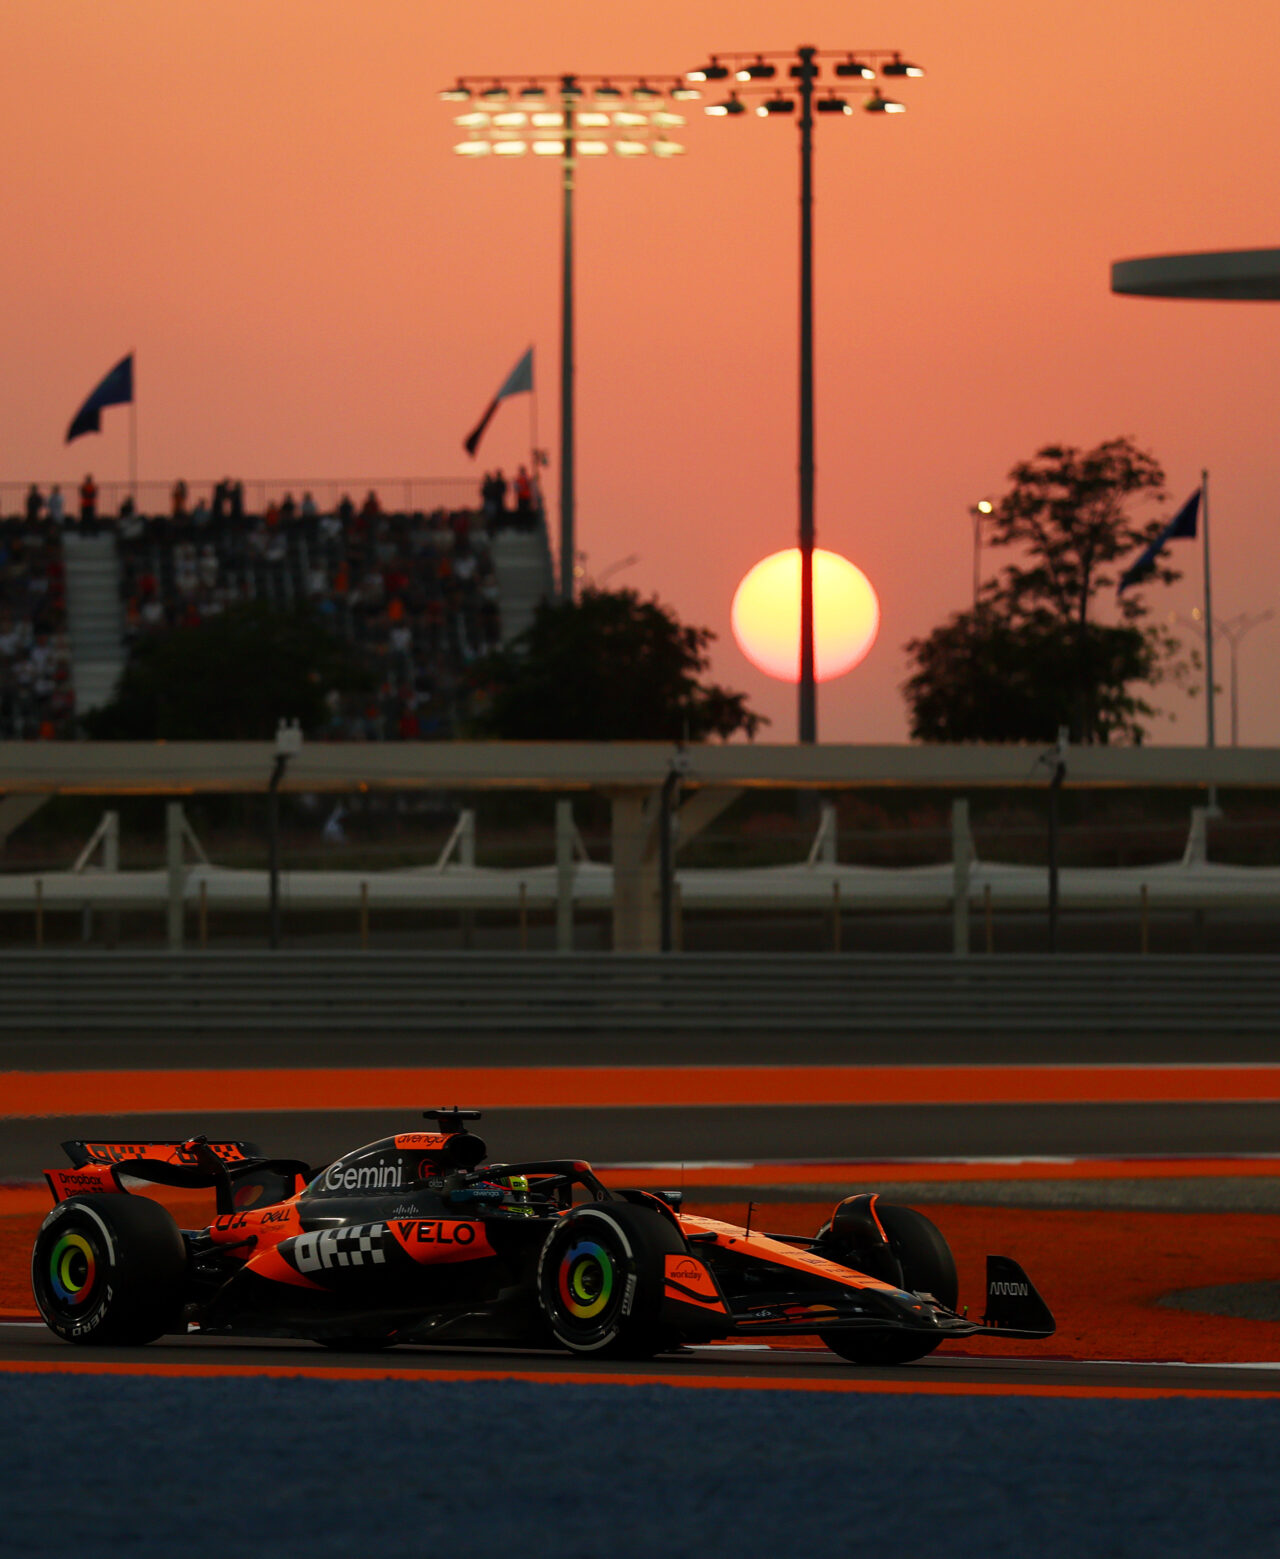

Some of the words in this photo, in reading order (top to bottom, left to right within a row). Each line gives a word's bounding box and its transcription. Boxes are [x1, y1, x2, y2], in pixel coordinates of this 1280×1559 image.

[58, 1172, 102, 1186] Dropbox
[325, 1158, 403, 1191] Gemini
[261, 1208, 291, 1224] DELL
[397, 1221, 476, 1245] VELO
[295, 1223, 387, 1273] OKX
